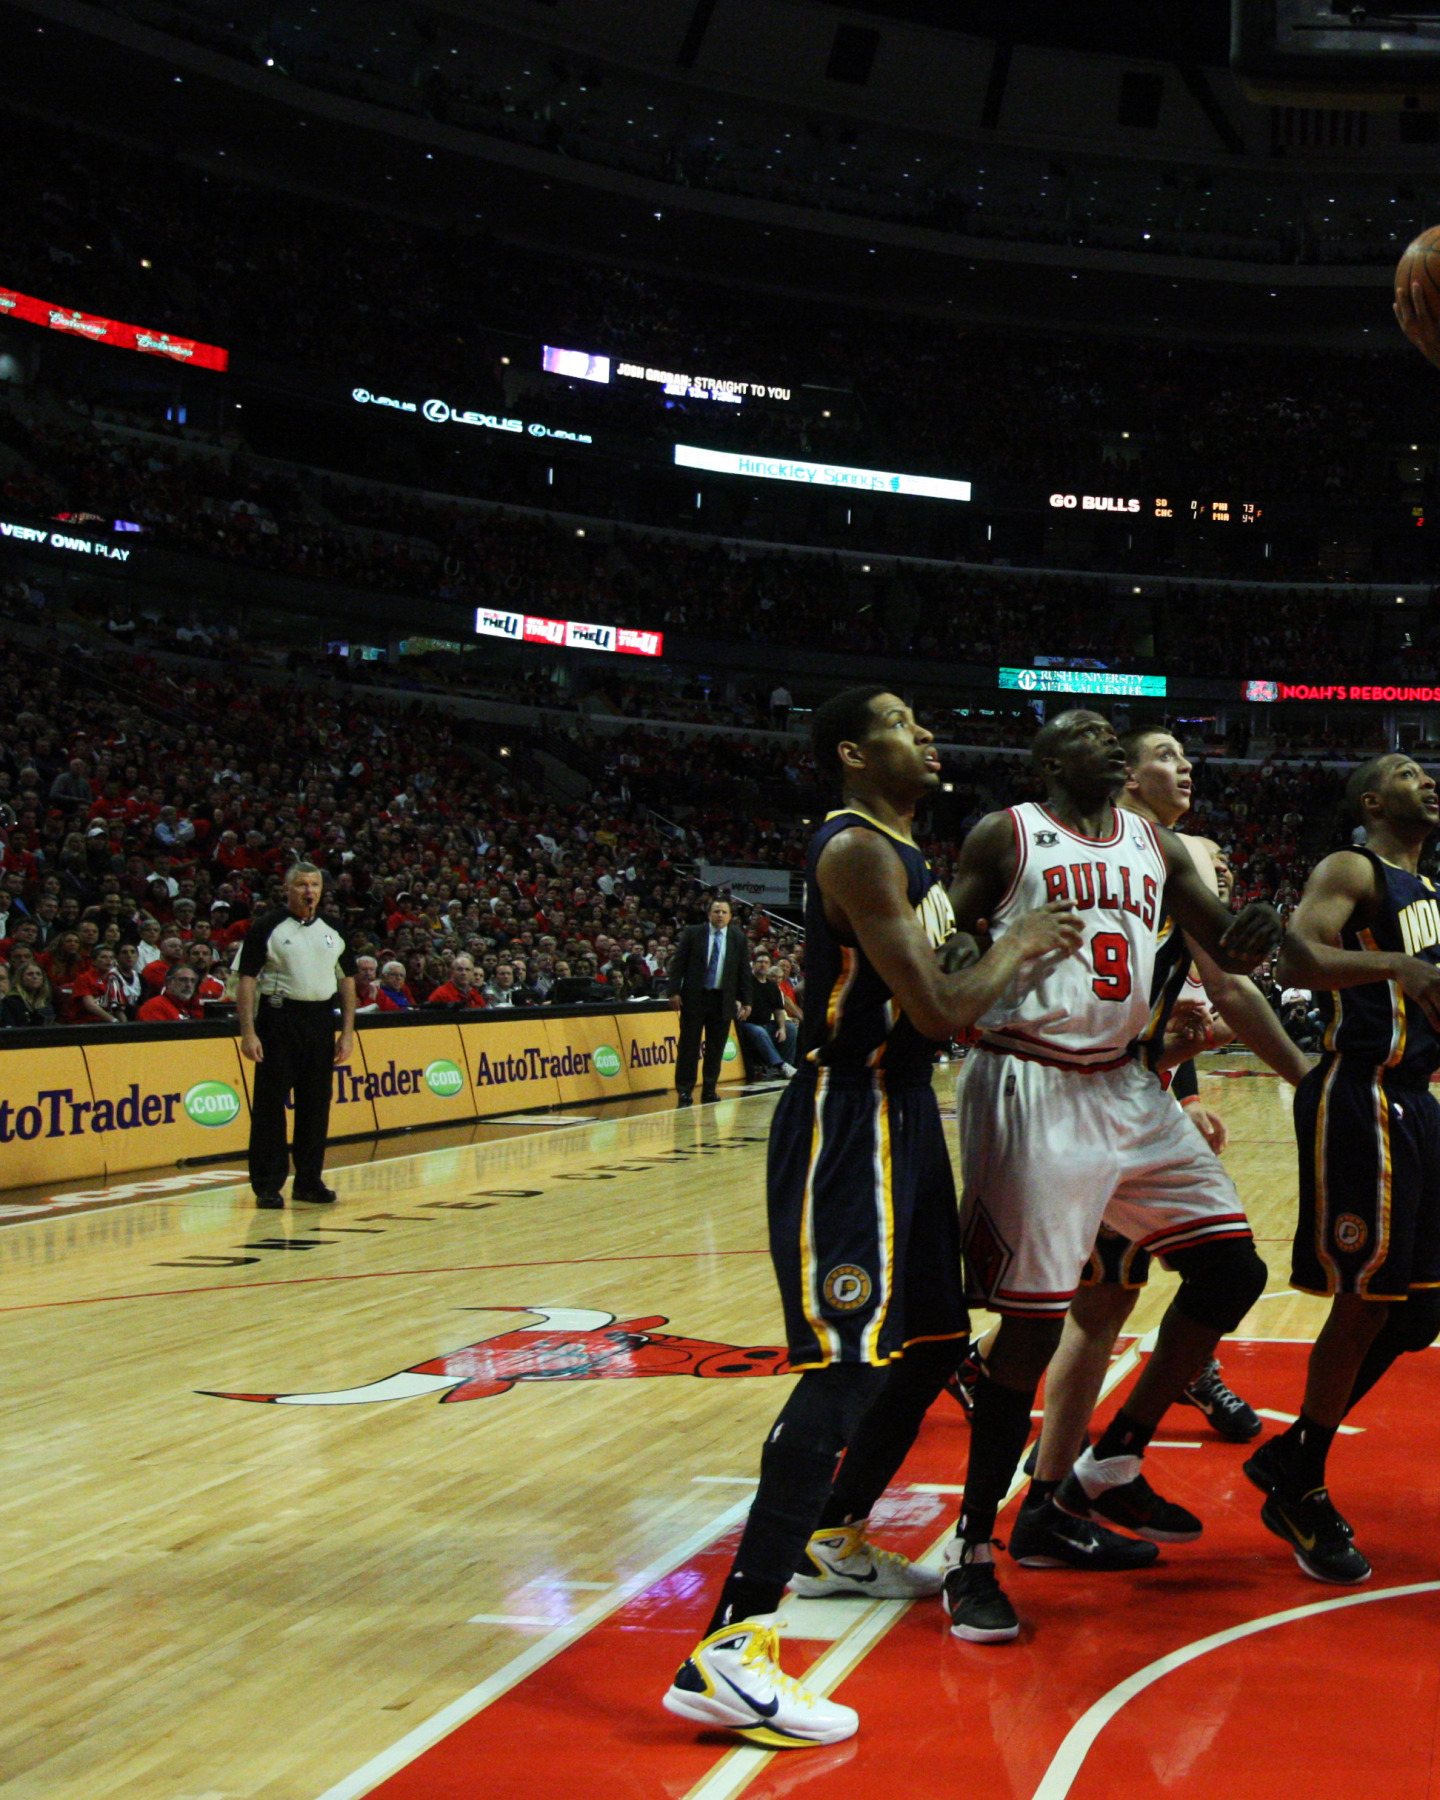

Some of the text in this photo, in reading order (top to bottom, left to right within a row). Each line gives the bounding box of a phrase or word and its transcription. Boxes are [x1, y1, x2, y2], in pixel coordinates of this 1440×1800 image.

[617, 362, 645, 379] JOSH
[646, 368, 692, 387] GROBAN:
[694, 376, 749, 396] STRAIGHT
[750, 383, 766, 398] TO
[767, 386, 791, 401] YOU
[370, 394, 417, 412] LEXUS
[451, 408, 523, 433] LEXUS
[546, 428, 593, 444] LEXUS
[737, 457, 818, 484] Hinckley
[1050, 494, 1141, 513] GO BULLS
[1155, 498, 1168, 507] SD
[1212, 502, 1229, 511] PHI
[1154, 508, 1174, 518] CHC
[1212, 512, 1231, 522] MIA
[0, 522, 130, 561] VERY OWN PLAY
[483, 616, 505, 629] THE
[572, 630, 597, 641] THE
[1040, 670, 1144, 685] RUSH UNIVERSITY
[1040, 681, 1093, 694] MEDICAL
[1282, 685, 1347, 699] NOAH'S
[1042, 862, 1157, 932] BULLS
[1090, 931, 1131, 1002] 9
[476, 1046, 619, 1087] AutoTrader .com
[427, 1069, 462, 1088] .com
[188, 1092, 239, 1115] .com
[151, 1188, 544, 1268] UNITED
